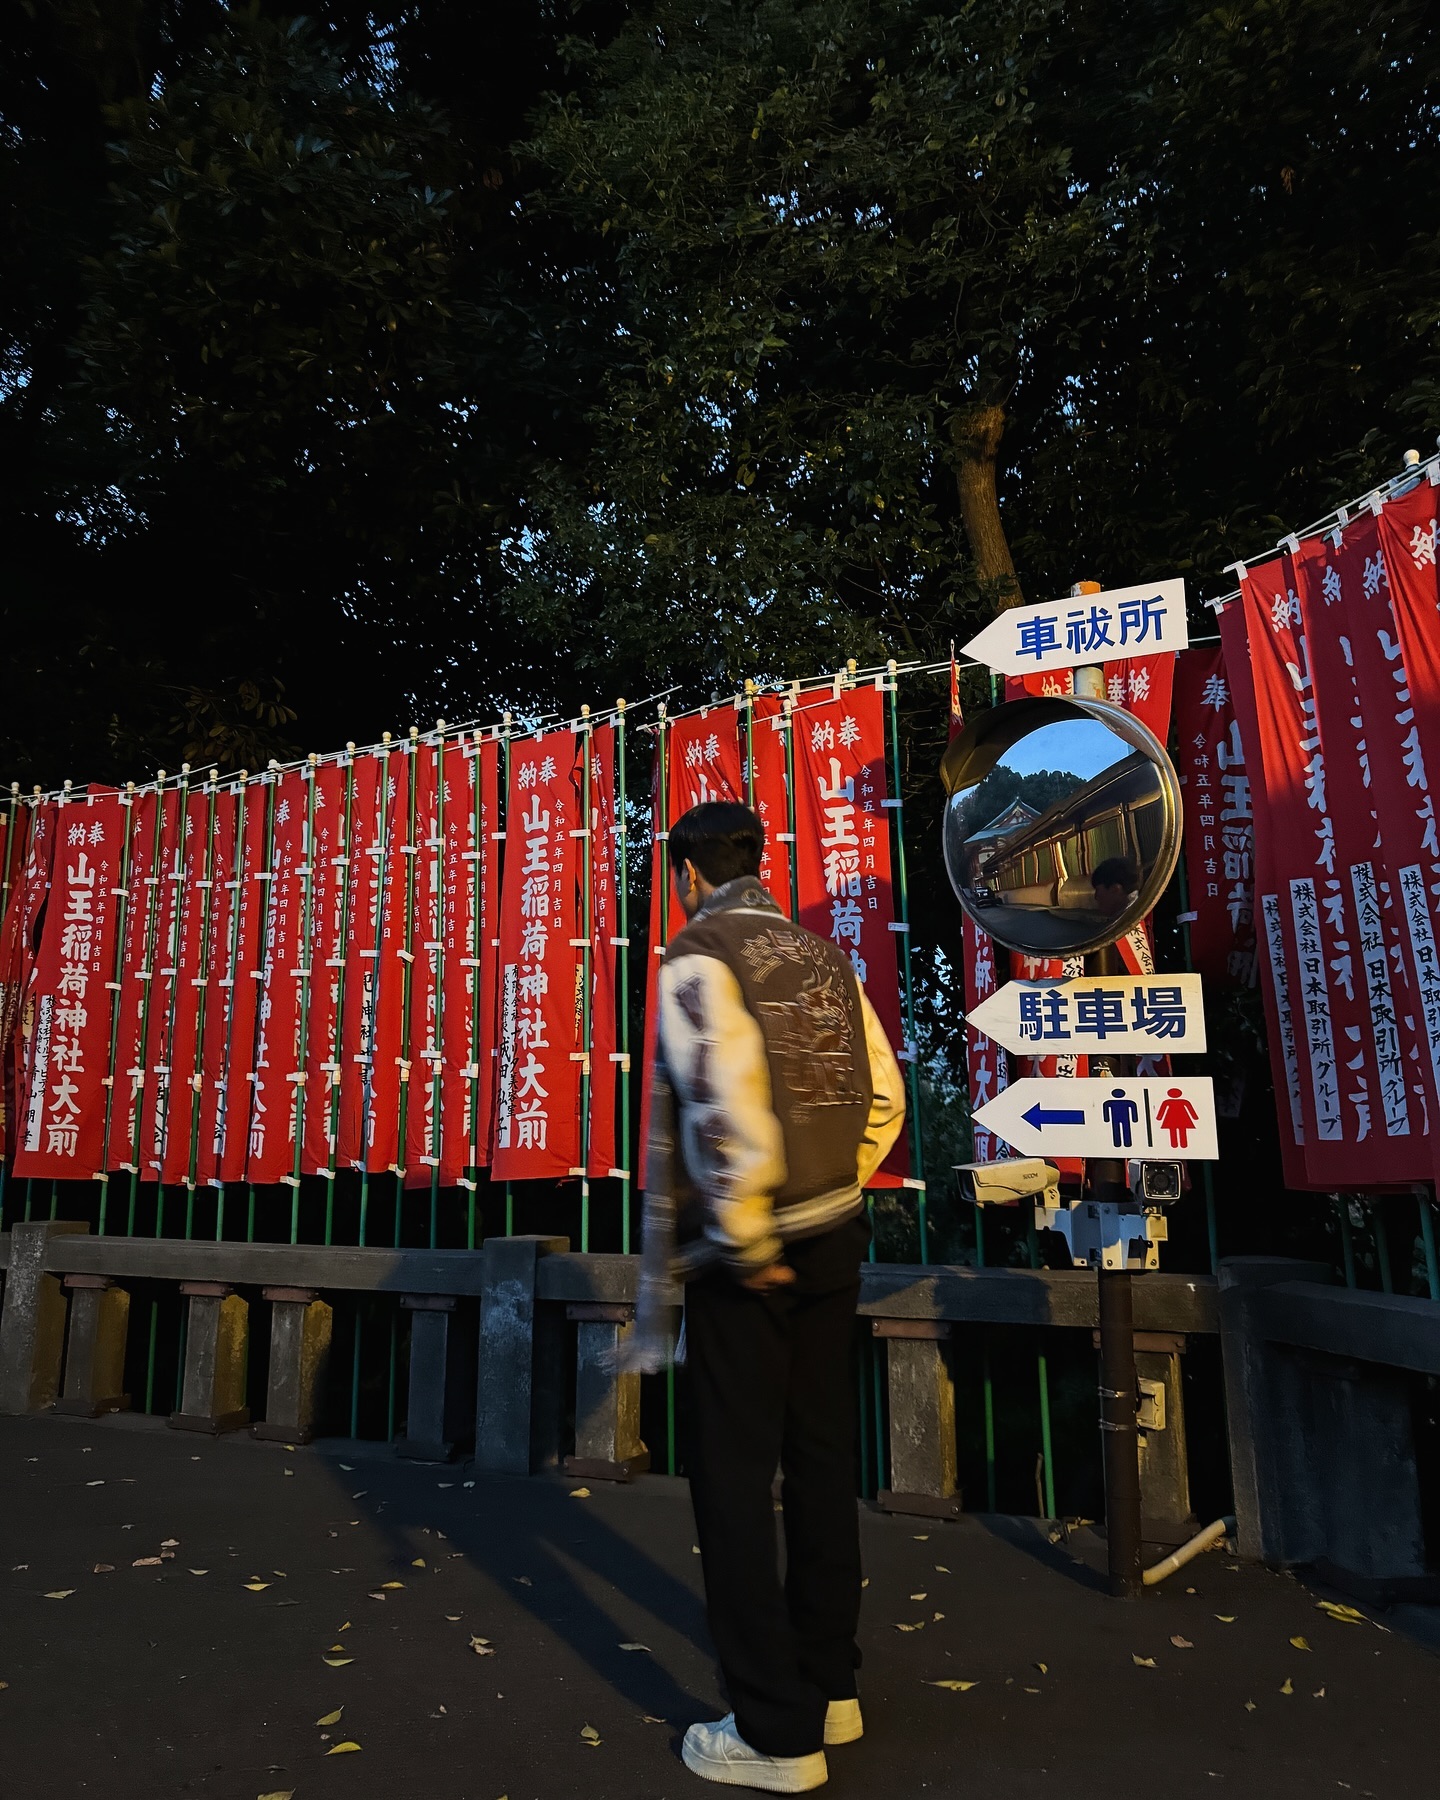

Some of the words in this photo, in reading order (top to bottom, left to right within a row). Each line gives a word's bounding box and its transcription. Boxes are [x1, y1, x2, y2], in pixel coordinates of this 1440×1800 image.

[1016, 595, 1168, 661] 車祓所
[316, 827, 330, 949] 令和五年四月吉日
[553, 799, 566, 929] 令和五年四月吉日
[860, 764, 879, 910] 令和五年四月吉日
[92, 859, 110, 973] 令和五年四月吉日
[278, 839, 293, 960] 令和五年四月吉日
[46, 851, 96, 1158] 山王稲荷神社大前
[516, 794, 549, 1154] 山王稲荷神社大前
[1020, 987, 1187, 1040] 駐車場
